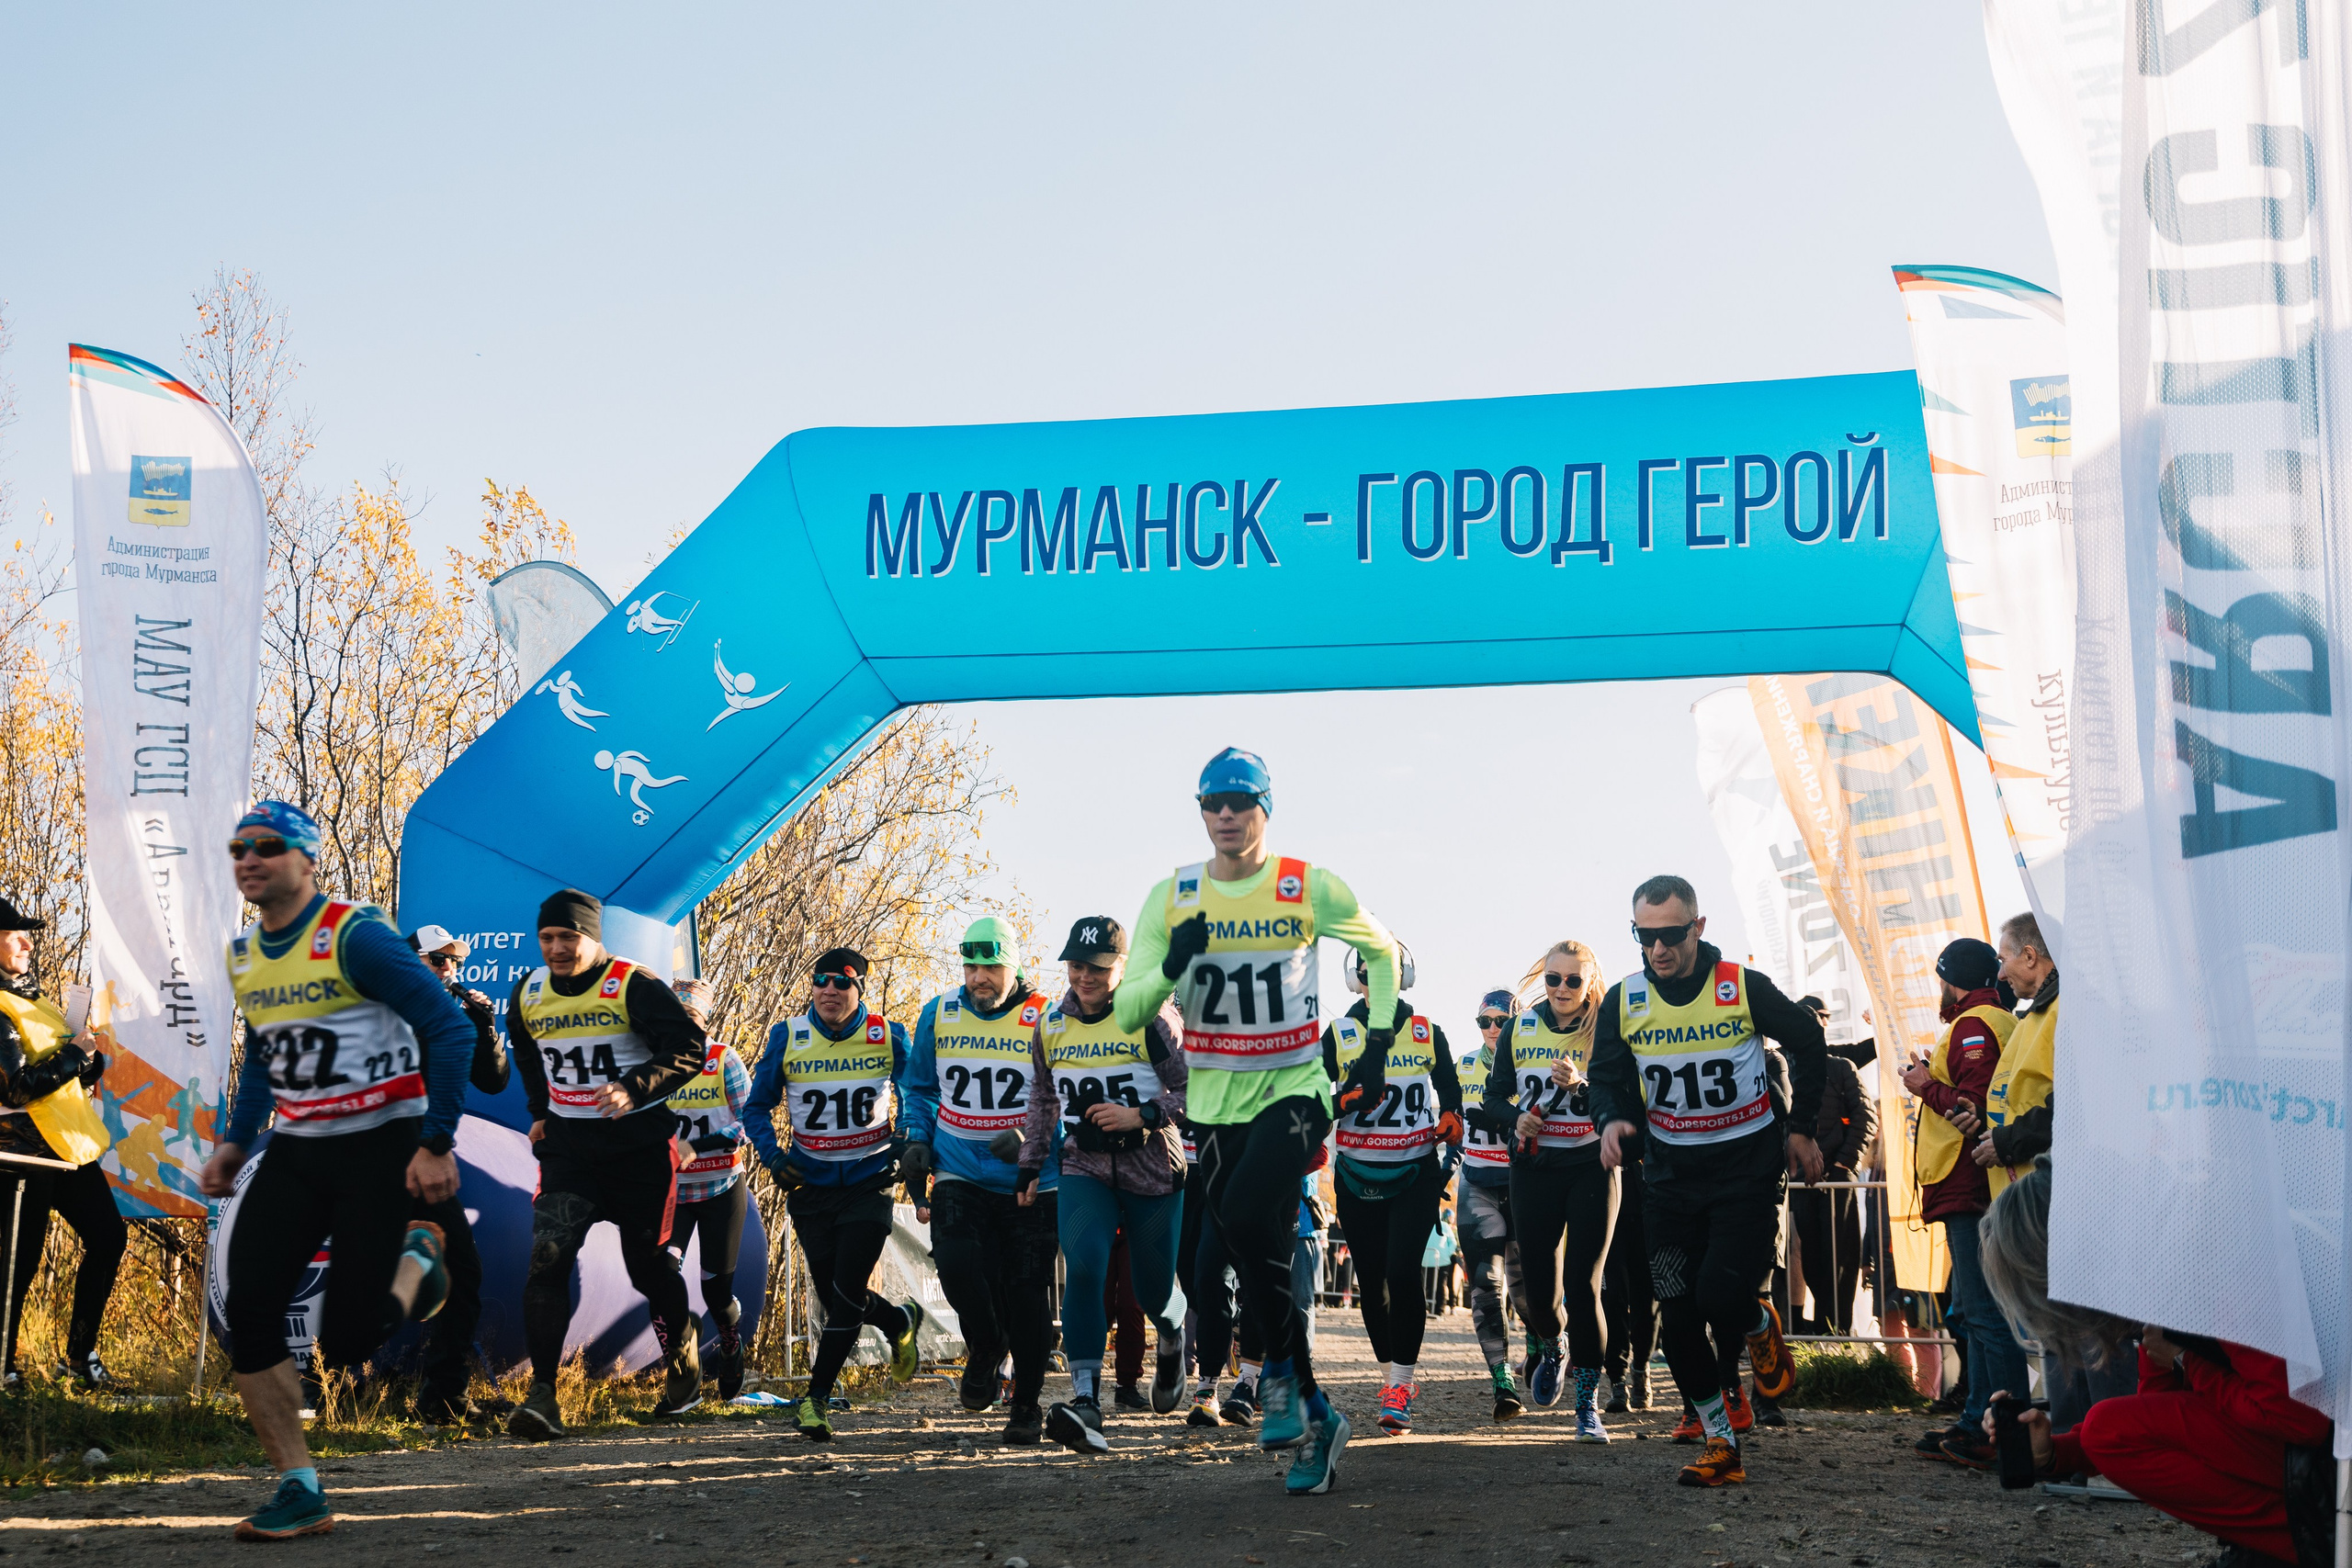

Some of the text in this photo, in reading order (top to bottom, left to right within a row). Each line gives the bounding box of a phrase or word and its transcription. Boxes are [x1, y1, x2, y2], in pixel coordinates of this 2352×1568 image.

[2000, 480, 2074, 504] Админист
[865, 431, 1890, 580] МУРМАНСК - ГОРОД ГЕРОЙ
[1993, 509, 2041, 533] города
[2045, 501, 2075, 525] Мур
[106, 535, 210, 562] Администрация
[101, 562, 218, 585] города Мурманска
[133, 614, 193, 708] МАУ
[130, 722, 190, 798] ГСЦ
[2030, 668, 2078, 832] культуре
[1080, 926, 1099, 944] NY
[1204, 919, 1304, 940] РМАНСК
[1195, 962, 1284, 1025] 211
[526, 1011, 627, 1032] МУРМАНСК
[1628, 1019, 1745, 1045] МУРМАНСК
[543, 1043, 623, 1085] 214
[1048, 1042, 1142, 1063] МУРМАНСК
[1515, 1047, 1584, 1063] МУРМАН
[789, 1057, 887, 1075] МУРМАНСК
[666, 1087, 720, 1101] МАНСК
[945, 1065, 1025, 1110] 212
[1645, 1058, 1737, 1111] 213
[802, 1086, 877, 1130] 216
[940, 1108, 1027, 1128] WWW.GORSPORT5
[1650, 1104, 1762, 1130] WWW.GORSPORT51.RU
[1542, 1124, 1593, 1134] ORSPORT5
